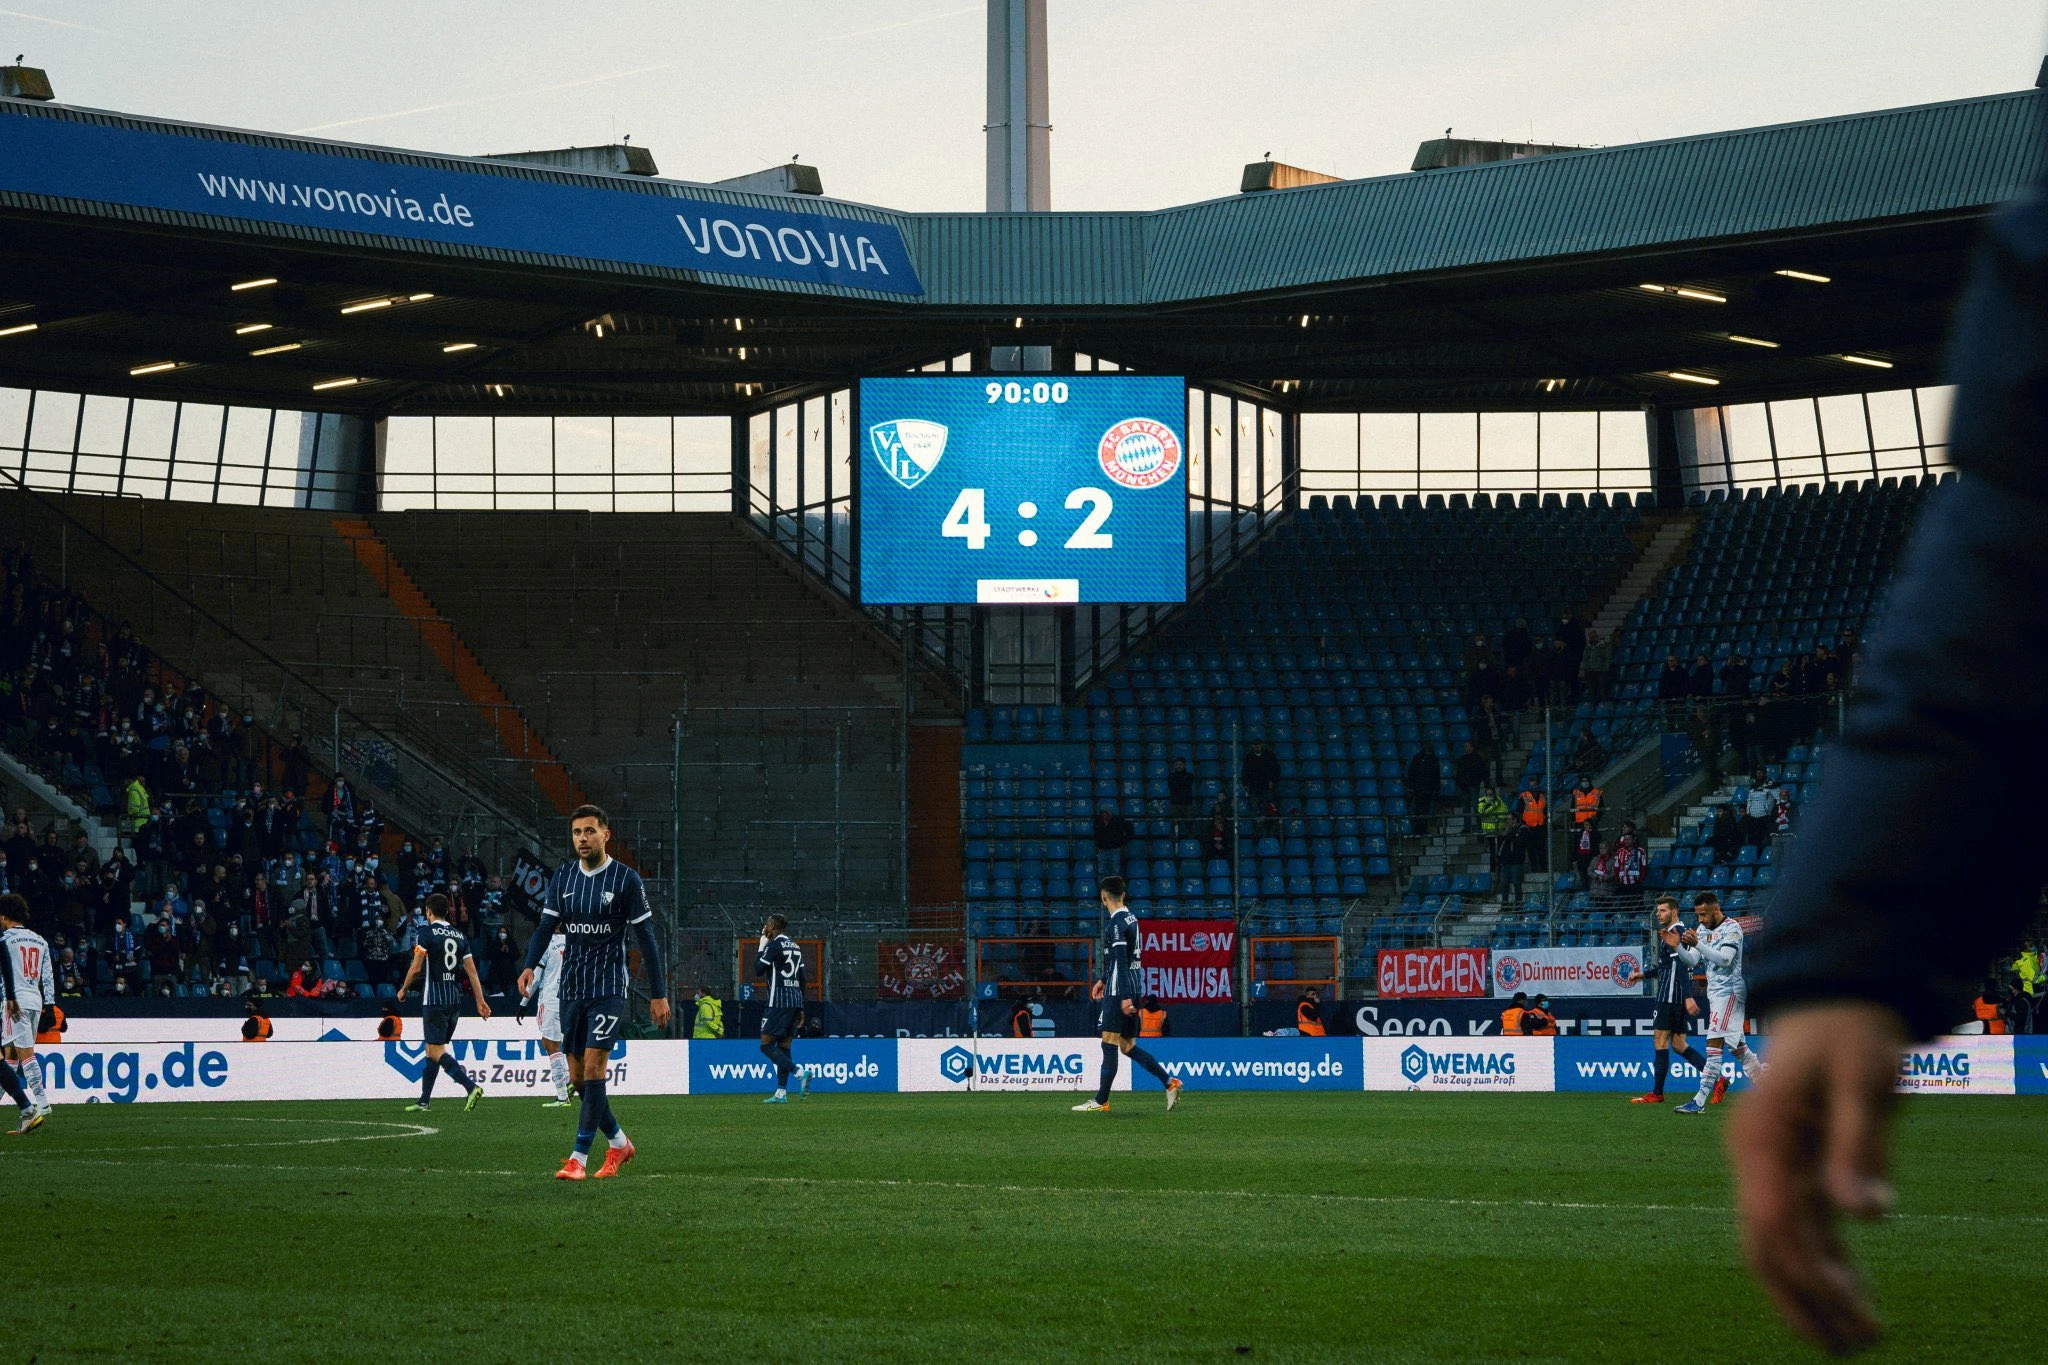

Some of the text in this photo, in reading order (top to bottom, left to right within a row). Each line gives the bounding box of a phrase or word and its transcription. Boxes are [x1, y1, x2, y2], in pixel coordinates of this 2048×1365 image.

[197, 172, 475, 228] www.vonovia.de
[985, 382, 1070, 404] 90:00
[1120, 422, 1176, 449] BAYERN
[941, 488, 991, 550] 4
[1063, 486, 1114, 550] 2
[432, 928, 464, 941] BOCHUM
[19, 946, 39, 979] 10
[444, 938, 458, 971] 8
[780, 950, 802, 978] 37
[895, 943, 950, 963] SVEN
[1380, 952, 1486, 993] GLEICHEN
[1522, 960, 1611, 982] Dümmer-See
[984, 984, 993, 997] 6
[592, 1014, 619, 1036] 27
[976, 1053, 1083, 1075] WEMAG
[1159, 1053, 1343, 1084] www.wemag.de
[1428, 1053, 1515, 1075] WEMAG
[1900, 1053, 1970, 1076] EMAG
[491, 1064, 537, 1087] Zeug
[980, 1075, 999, 1084] Das
[1002, 1075, 1029, 1086] Zeug
[1056, 1075, 1083, 1087] Profi
[1432, 1075, 1516, 1087] Das Zeug zum Profi
[1922, 1079, 1943, 1087] zum
[1945, 1077, 1970, 1089] Profi
